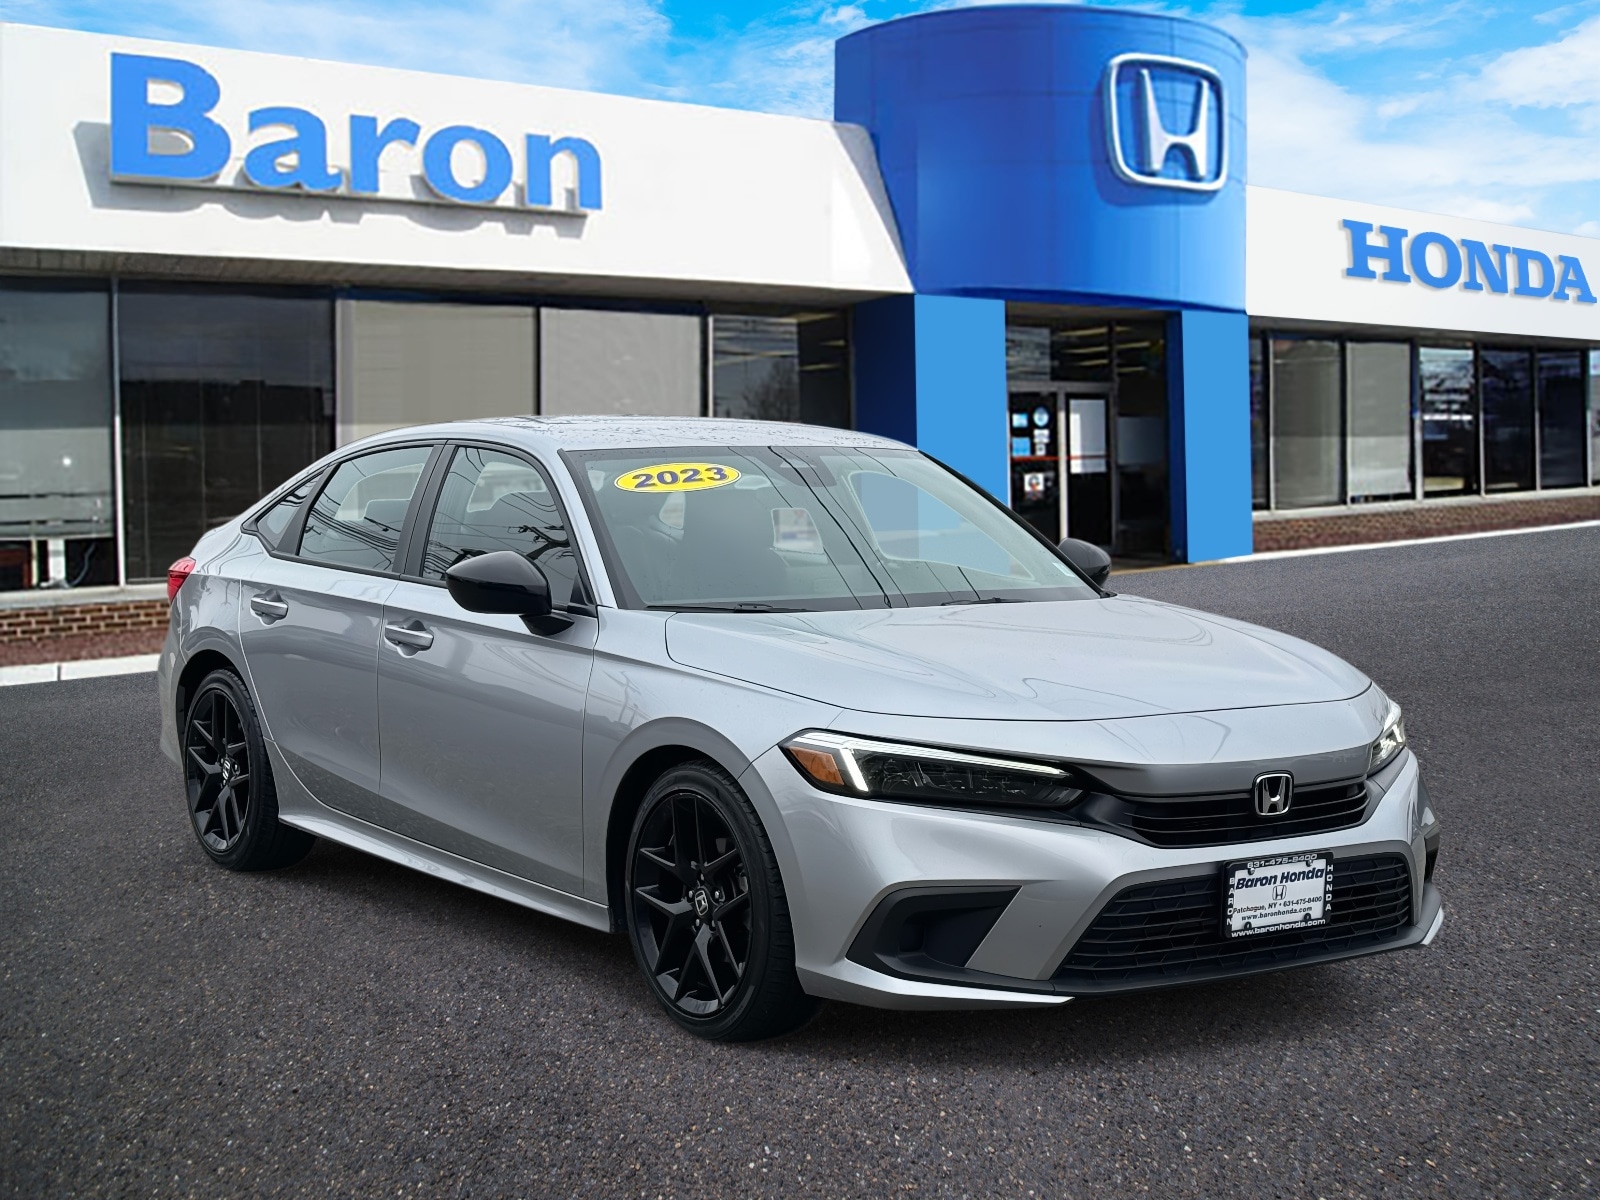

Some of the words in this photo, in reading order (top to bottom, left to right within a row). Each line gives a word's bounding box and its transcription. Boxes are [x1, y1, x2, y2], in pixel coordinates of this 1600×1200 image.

[110, 52, 602, 210] Baron
[1342, 218, 1598, 304] HONDA
[632, 467, 730, 488] 2023
[1235, 874, 1278, 890] Baron
[1280, 867, 1325, 884] Honda
[1242, 905, 1313, 921] www.baronhonda.com
[1231, 919, 1326, 937] www.baronhonda.com
